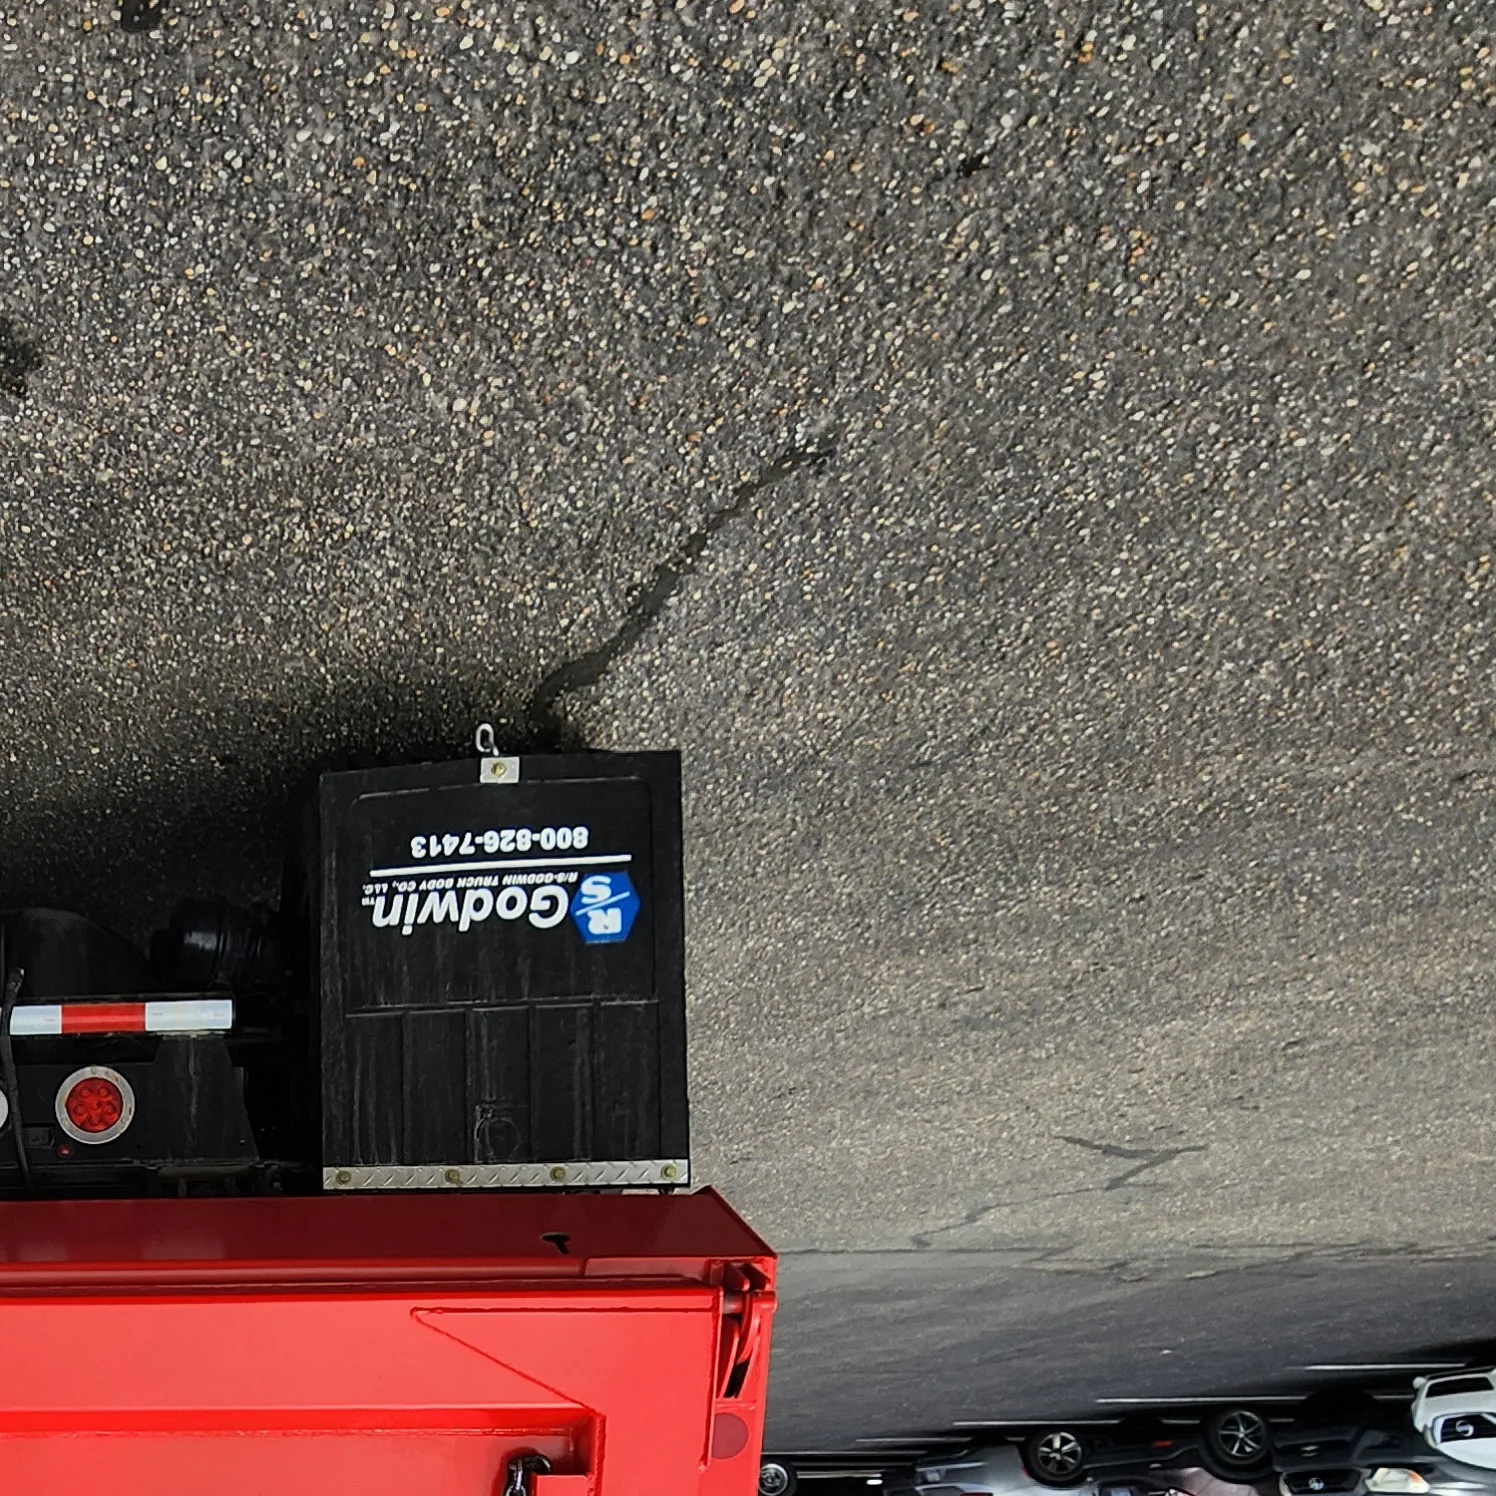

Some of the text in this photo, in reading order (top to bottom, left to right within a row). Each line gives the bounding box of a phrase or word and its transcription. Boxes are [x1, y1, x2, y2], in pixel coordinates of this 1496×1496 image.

[411, 826, 588, 858] 800-826-7413
[419, 877, 454, 891] BODY
[457, 875, 499, 889] TRUCK
[372, 885, 568, 935] Godwin
